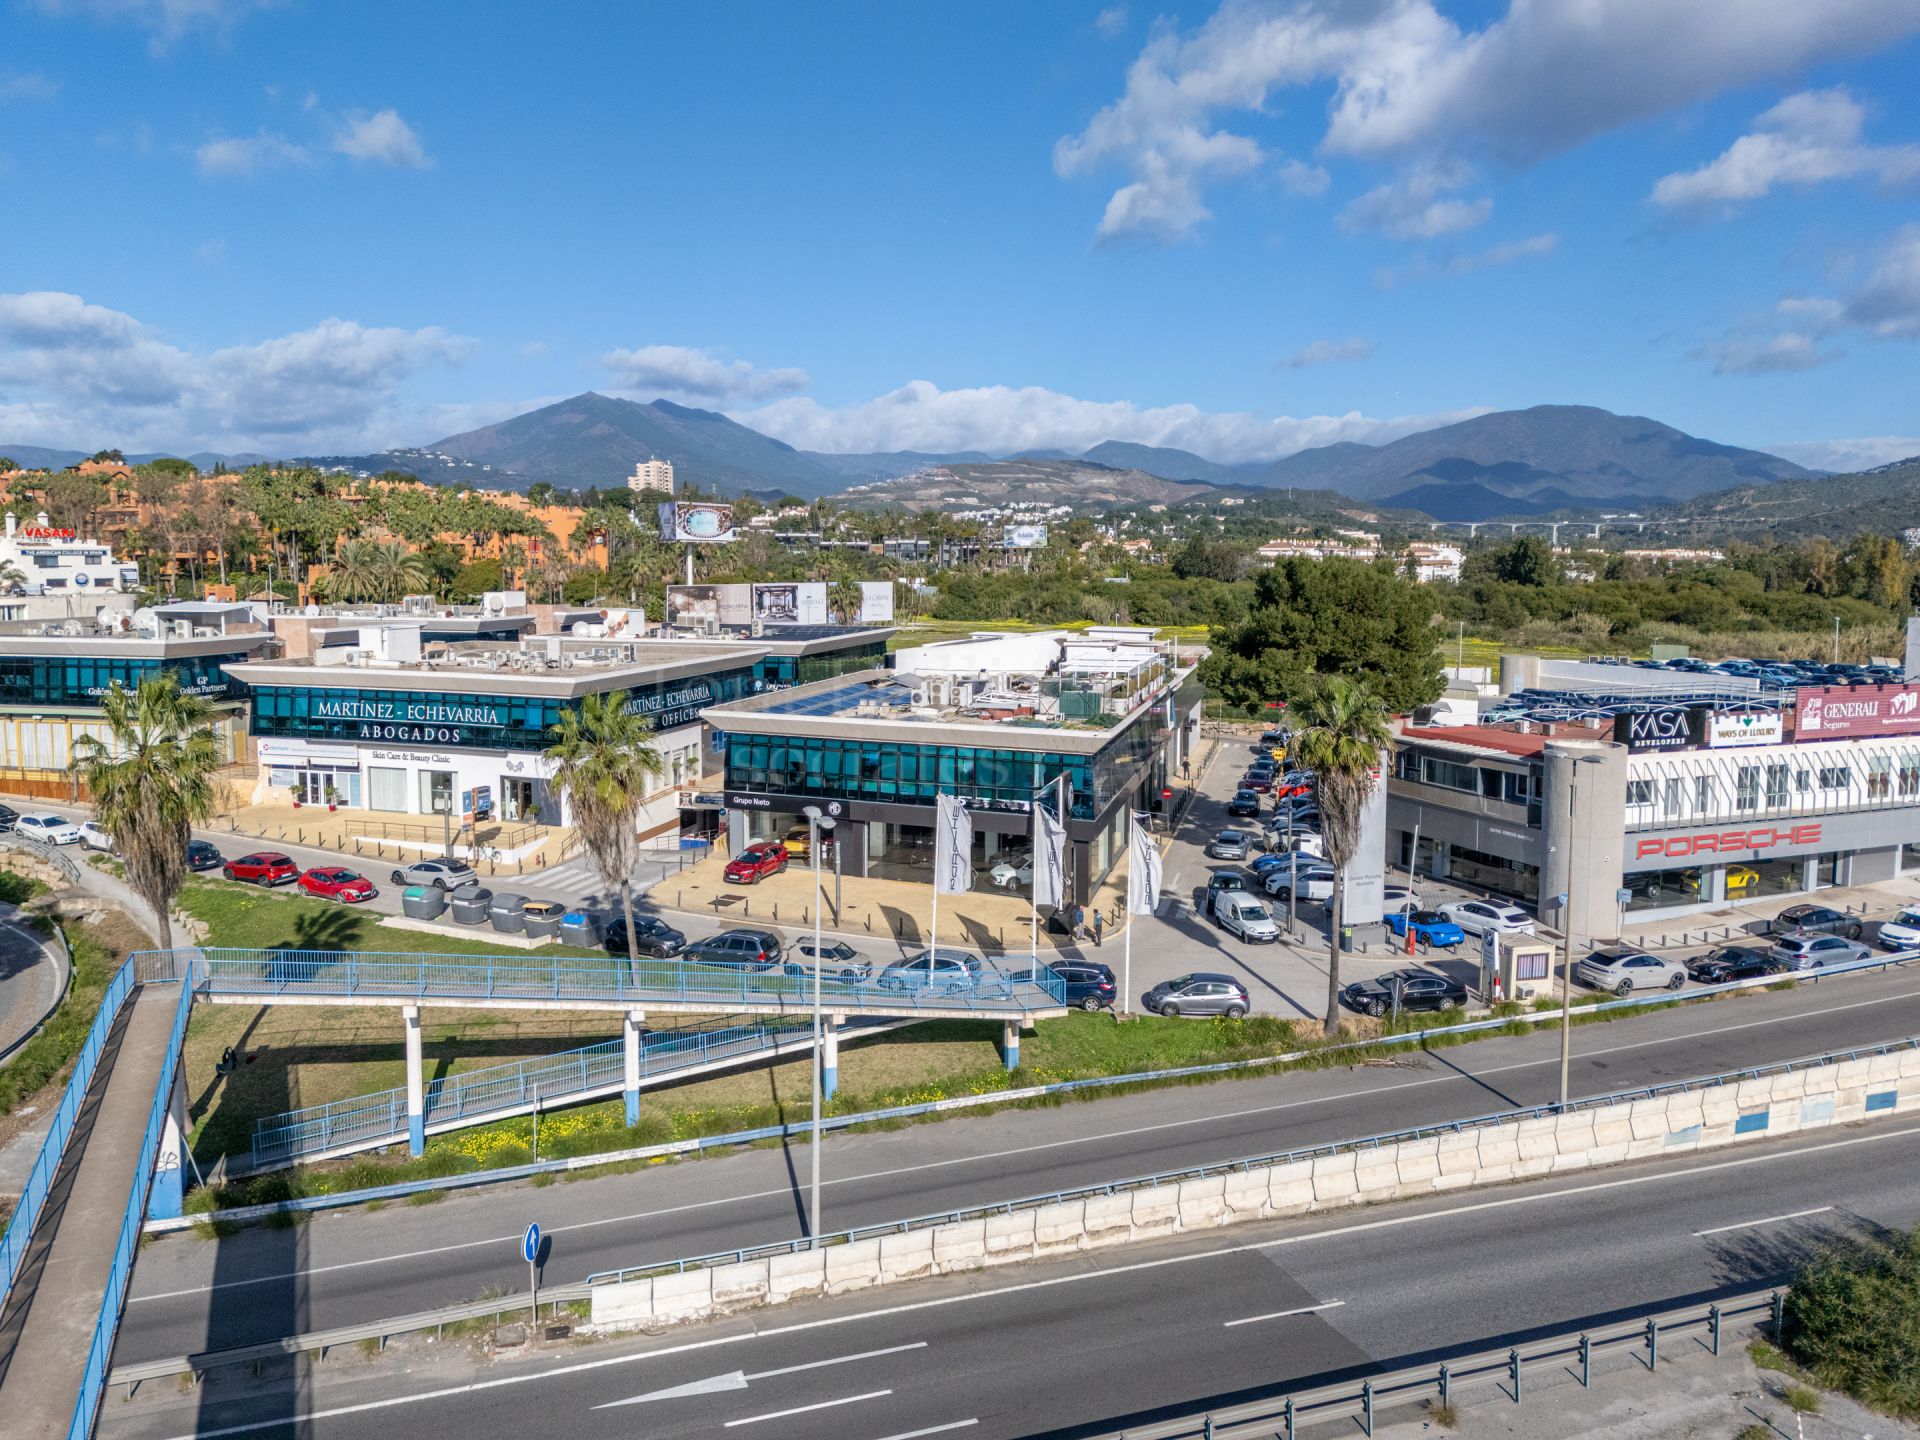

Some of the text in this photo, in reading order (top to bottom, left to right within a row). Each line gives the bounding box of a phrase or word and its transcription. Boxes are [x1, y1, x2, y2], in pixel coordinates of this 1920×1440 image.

[180, 684, 227, 695] Golden Partners
[621, 695, 661, 716] MARTÍNEZ
[667, 684, 710, 707] ECHEVARRÍA
[318, 700, 394, 718] MARTÍNEZ
[407, 705, 498, 724] ECHEVARRÍA
[1824, 701, 1879, 718] GENERALI
[1630, 712, 1690, 738] KASA
[1718, 727, 1777, 738] WAYS OF LUXURY
[1823, 721, 1850, 730] Seguros
[361, 725, 460, 742] ABOGADOS
[1635, 737, 1686, 748] DEVELOPERS
[372, 751, 386, 759] Skin
[387, 752, 401, 760] Care
[410, 753, 430, 764] Beauty
[432, 755, 451, 763] Clinic
[733, 797, 770, 806] Grupo Nieto
[1636, 823, 1822, 860] PORSCHE
